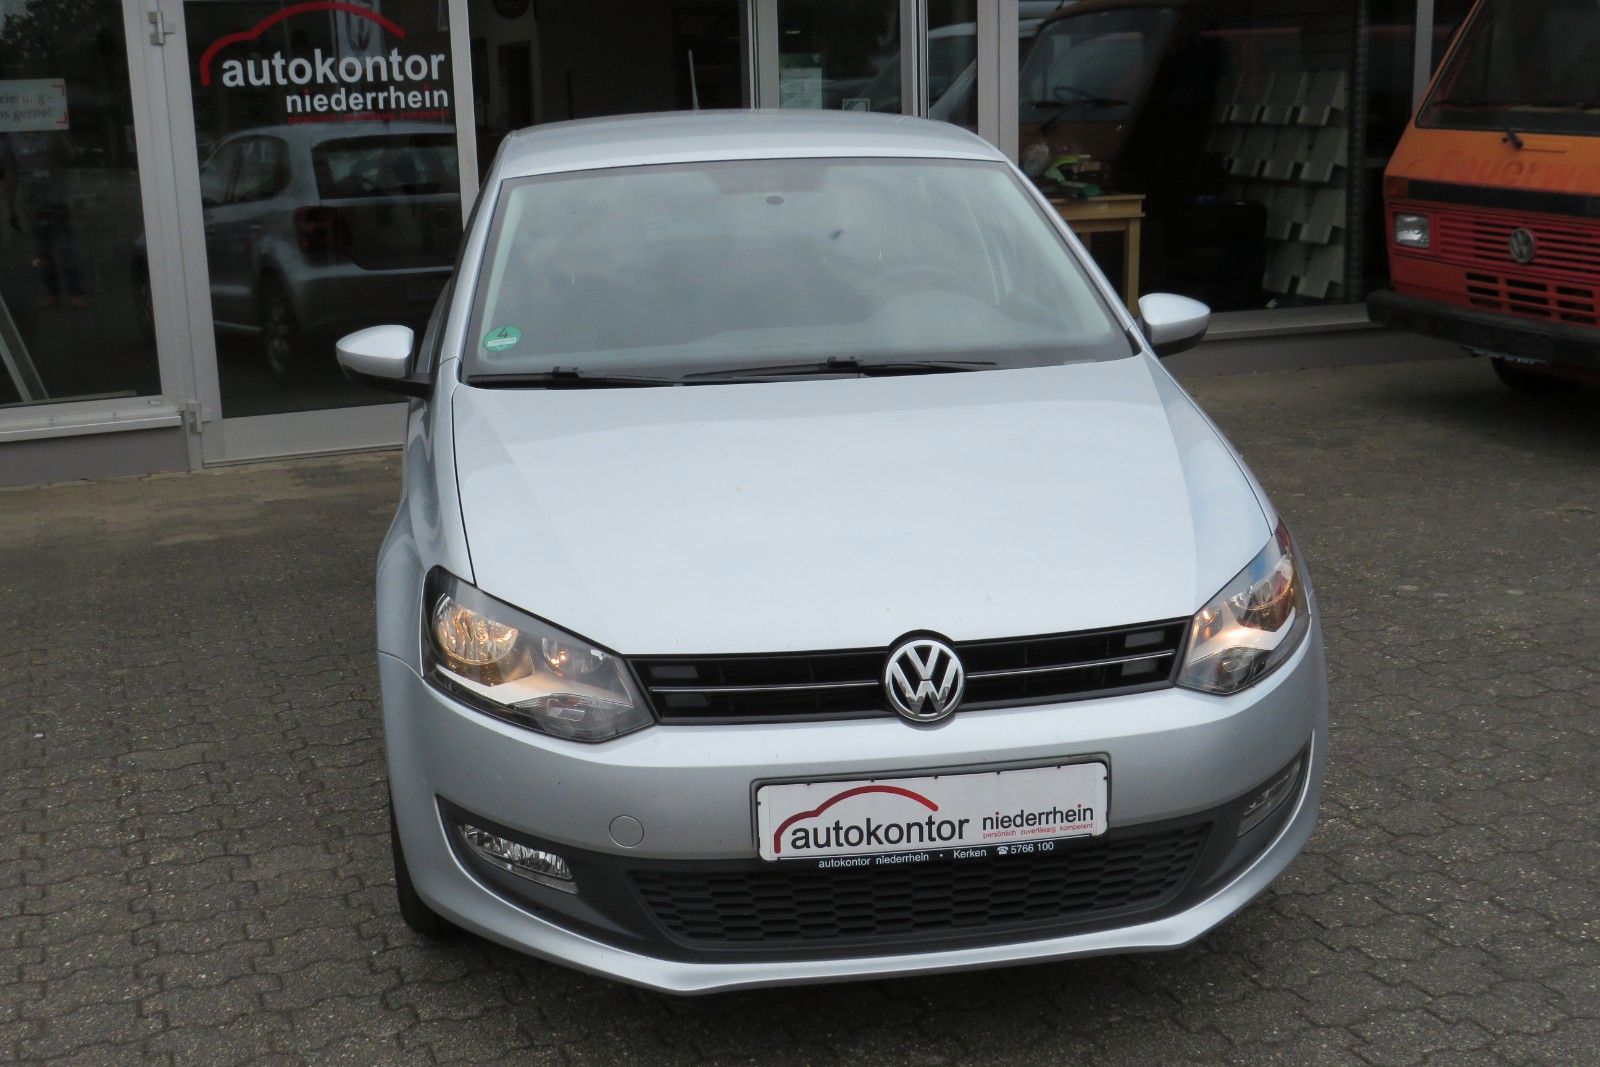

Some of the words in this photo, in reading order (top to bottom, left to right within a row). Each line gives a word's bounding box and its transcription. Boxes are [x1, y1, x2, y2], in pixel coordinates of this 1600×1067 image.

[222, 48, 446, 87] autokontor
[286, 84, 448, 113] niederrhein
[497, 326, 509, 338] 4
[983, 804, 1094, 830] niederrhein
[791, 815, 970, 849] autokontor
[818, 856, 870, 869] autokontor
[875, 853, 930, 865] niederrhein
[953, 849, 987, 859] Kerken
[1010, 843, 1034, 854] 5766
[1037, 841, 1054, 852] 100
